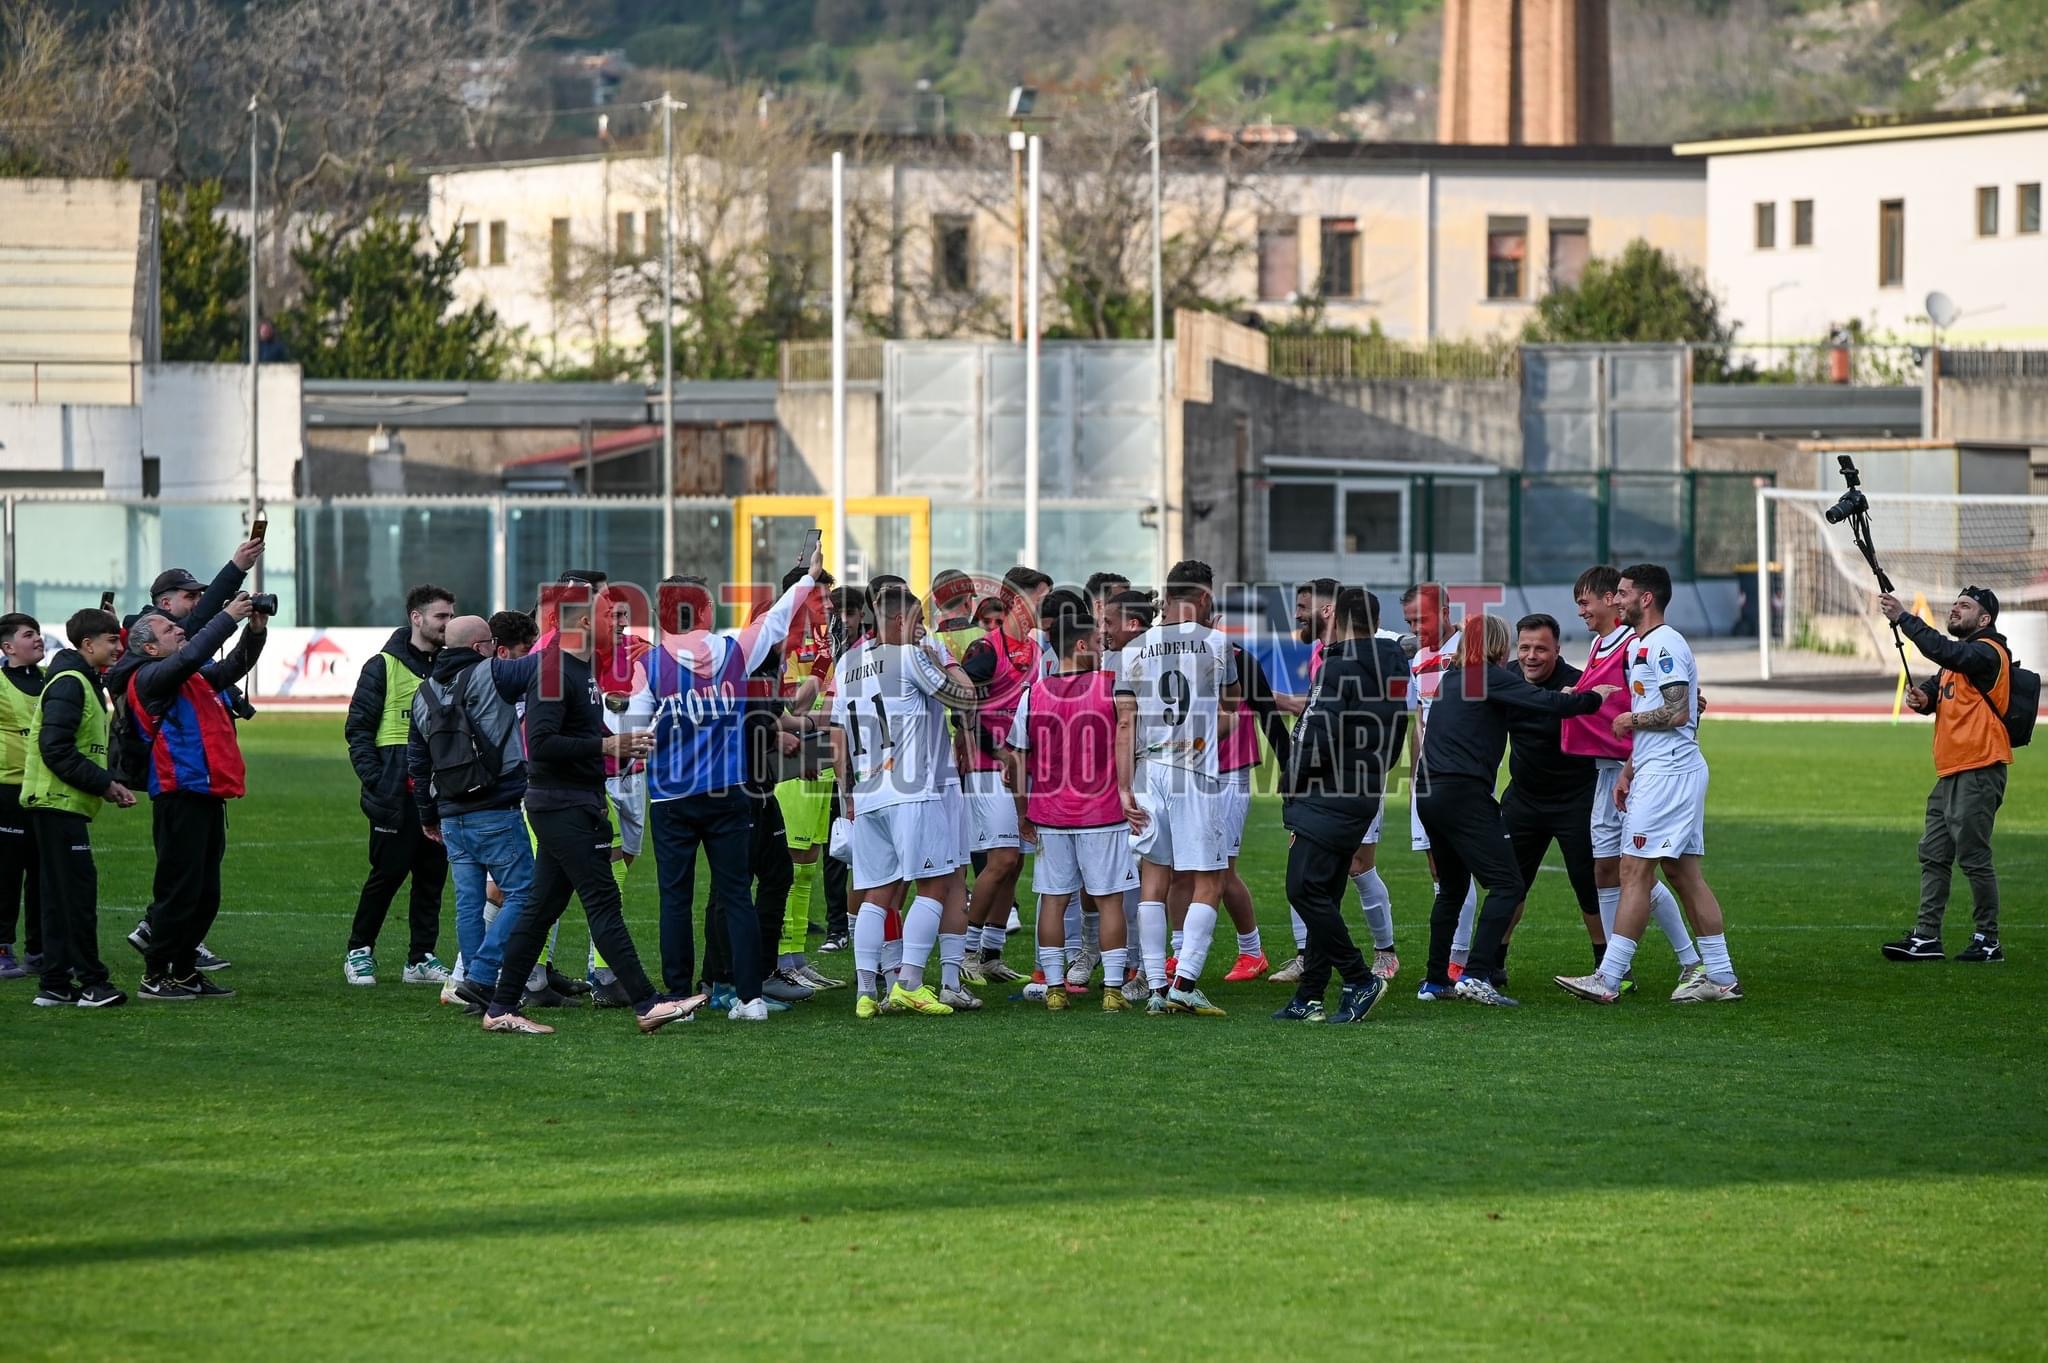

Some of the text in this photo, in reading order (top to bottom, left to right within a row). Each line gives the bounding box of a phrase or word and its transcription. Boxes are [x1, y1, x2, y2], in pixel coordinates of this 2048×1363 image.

[844, 660, 884, 685] LIURNI
[1140, 640, 1207, 660] CARDELLA
[667, 680, 736, 729] FOTO
[1158, 670, 1191, 726] 9
[846, 692, 895, 756] 11
